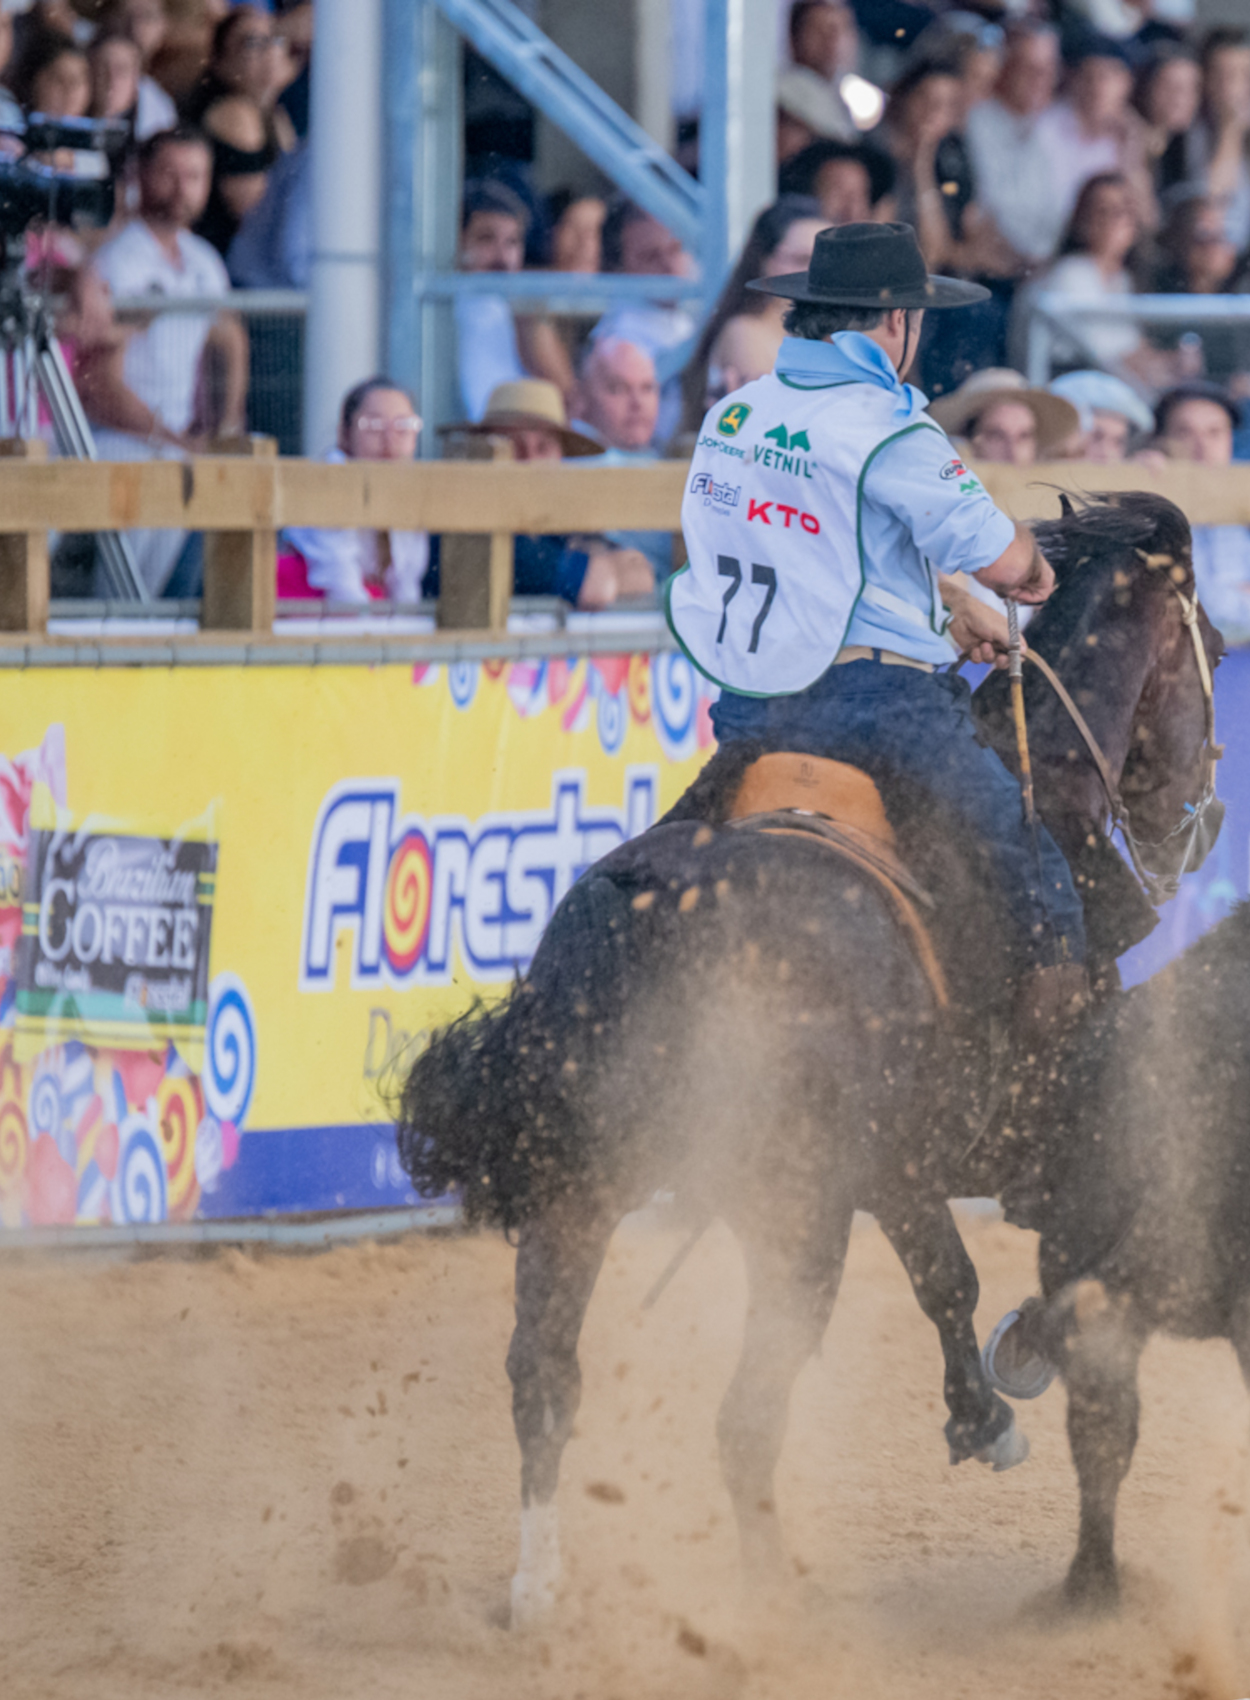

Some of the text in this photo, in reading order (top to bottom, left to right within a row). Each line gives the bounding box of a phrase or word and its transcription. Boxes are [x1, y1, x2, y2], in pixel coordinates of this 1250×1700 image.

[753, 444, 813, 479] VETNIL
[747, 498, 820, 535] KTO
[716, 554, 777, 654] 77
[38, 877, 199, 971] COFFEE
[303, 772, 658, 982] Florest
